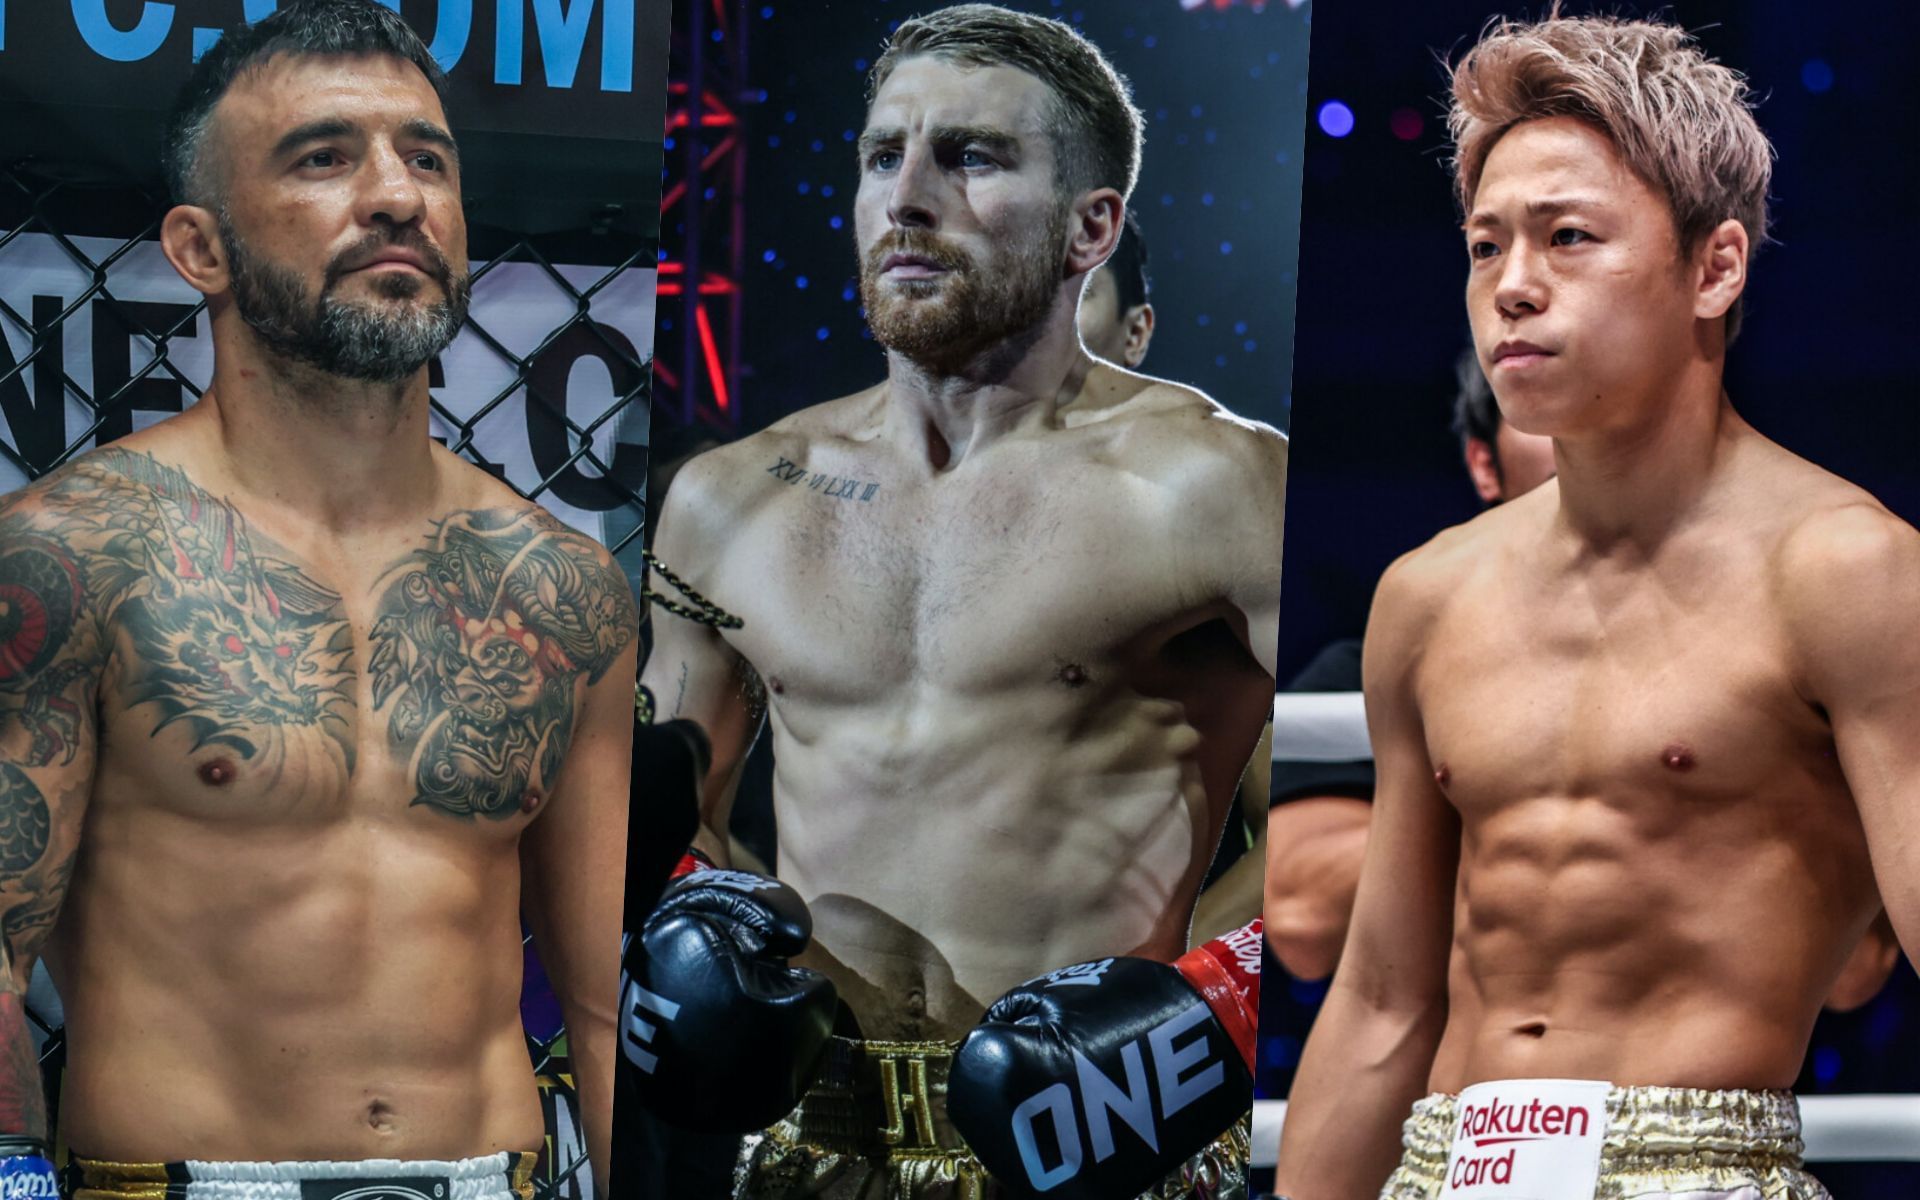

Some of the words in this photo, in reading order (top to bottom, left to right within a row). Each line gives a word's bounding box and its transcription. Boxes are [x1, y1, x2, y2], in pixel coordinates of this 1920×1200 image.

[1011, 1000, 1225, 1192] ONE
[1459, 1097, 1590, 1141] Rakuten
[1451, 1148, 1516, 1190] Card
